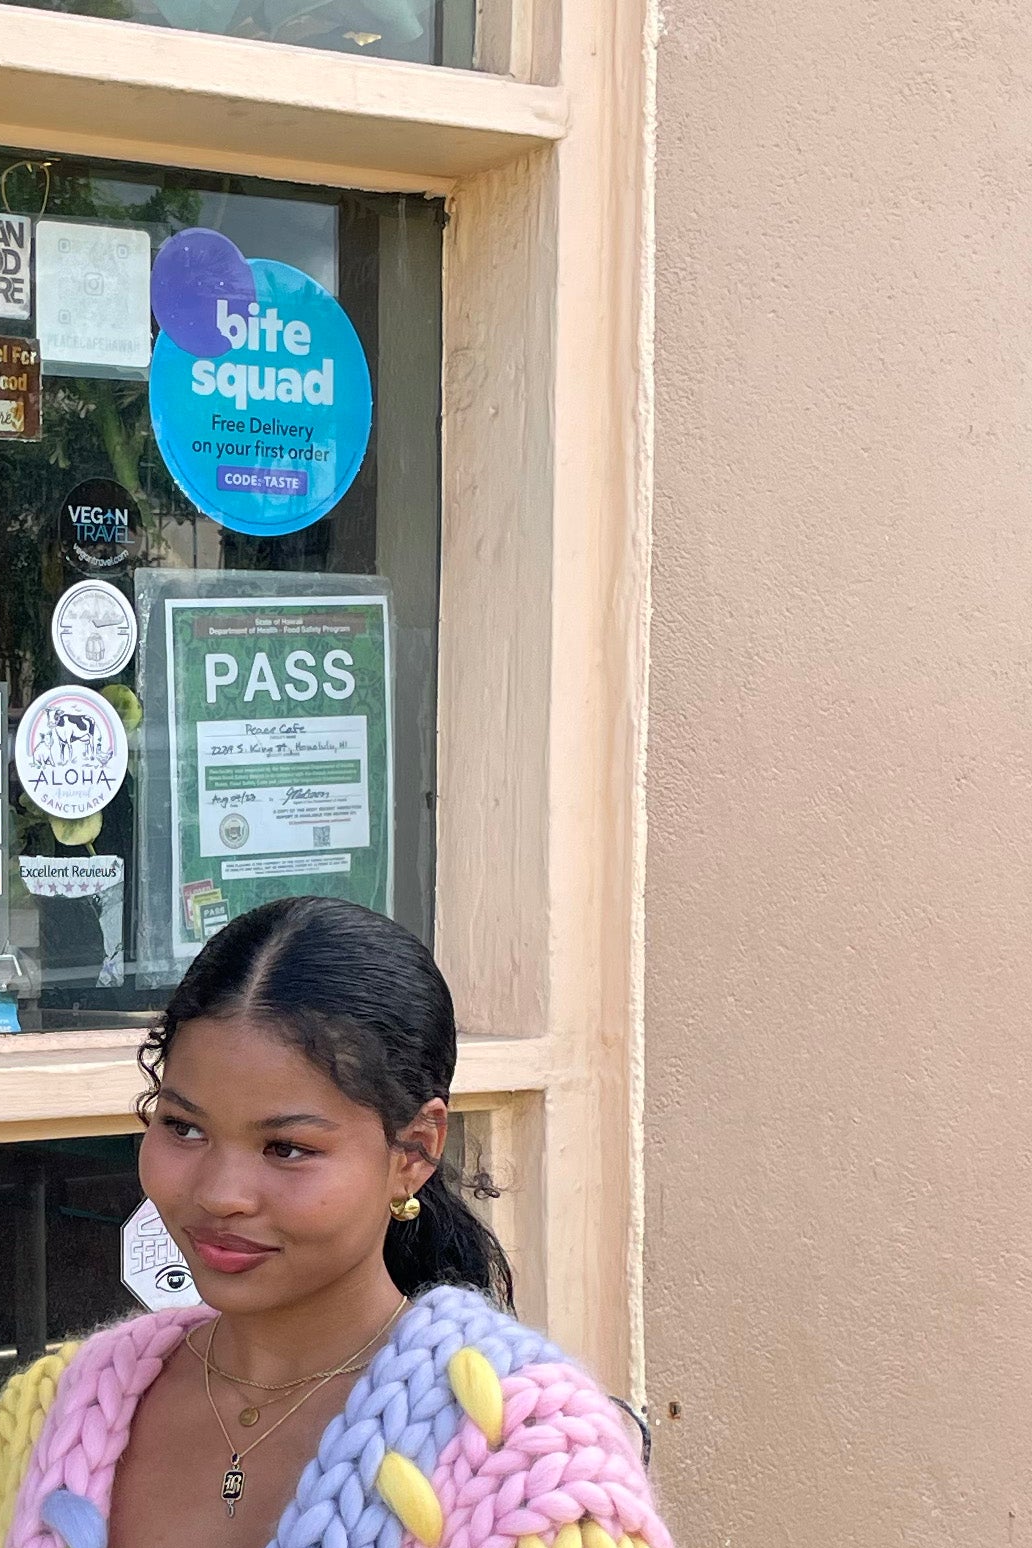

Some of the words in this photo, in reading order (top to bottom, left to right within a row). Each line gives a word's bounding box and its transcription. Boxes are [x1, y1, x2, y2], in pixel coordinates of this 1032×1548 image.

[216, 299, 311, 356] bite
[11, 347, 38, 366] For
[191, 358, 334, 410] squad
[211, 415, 245, 433] Free
[249, 417, 314, 443] Delivery
[191, 440, 212, 454] on
[215, 442, 252, 459] your
[254, 441, 284, 459] first
[288, 445, 330, 463] order
[224, 472, 262, 487] CODE:
[264, 474, 300, 489] TASTE
[73, 522, 135, 544] TRAVEL
[205, 649, 356, 704] PASS
[28, 768, 116, 792] ALOHA
[41, 793, 105, 813] SANCTUARY
[19, 865, 69, 878] Excellent
[72, 865, 116, 878] Reviews
[137, 1212, 168, 1237] C
[130, 1237, 184, 1275] SECU
